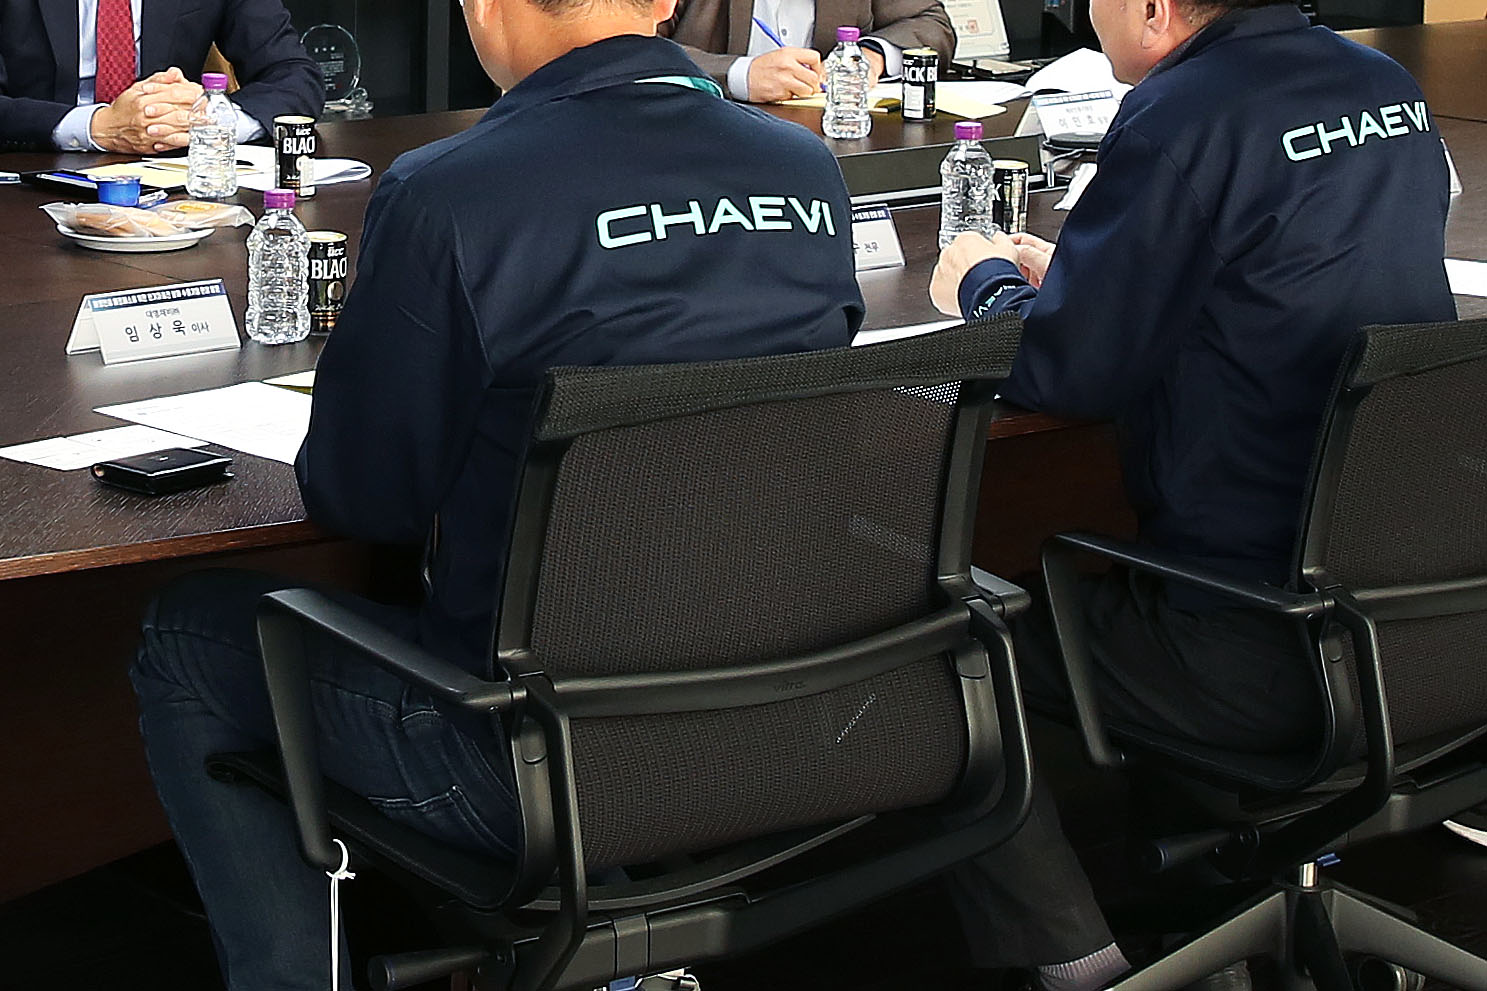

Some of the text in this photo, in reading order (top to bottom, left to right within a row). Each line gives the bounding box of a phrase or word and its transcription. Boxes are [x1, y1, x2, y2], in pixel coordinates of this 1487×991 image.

[283, 136, 316, 155] BLAC
[1282, 101, 1430, 162] CHAEVI
[596, 196, 837, 249] CHAEVI
